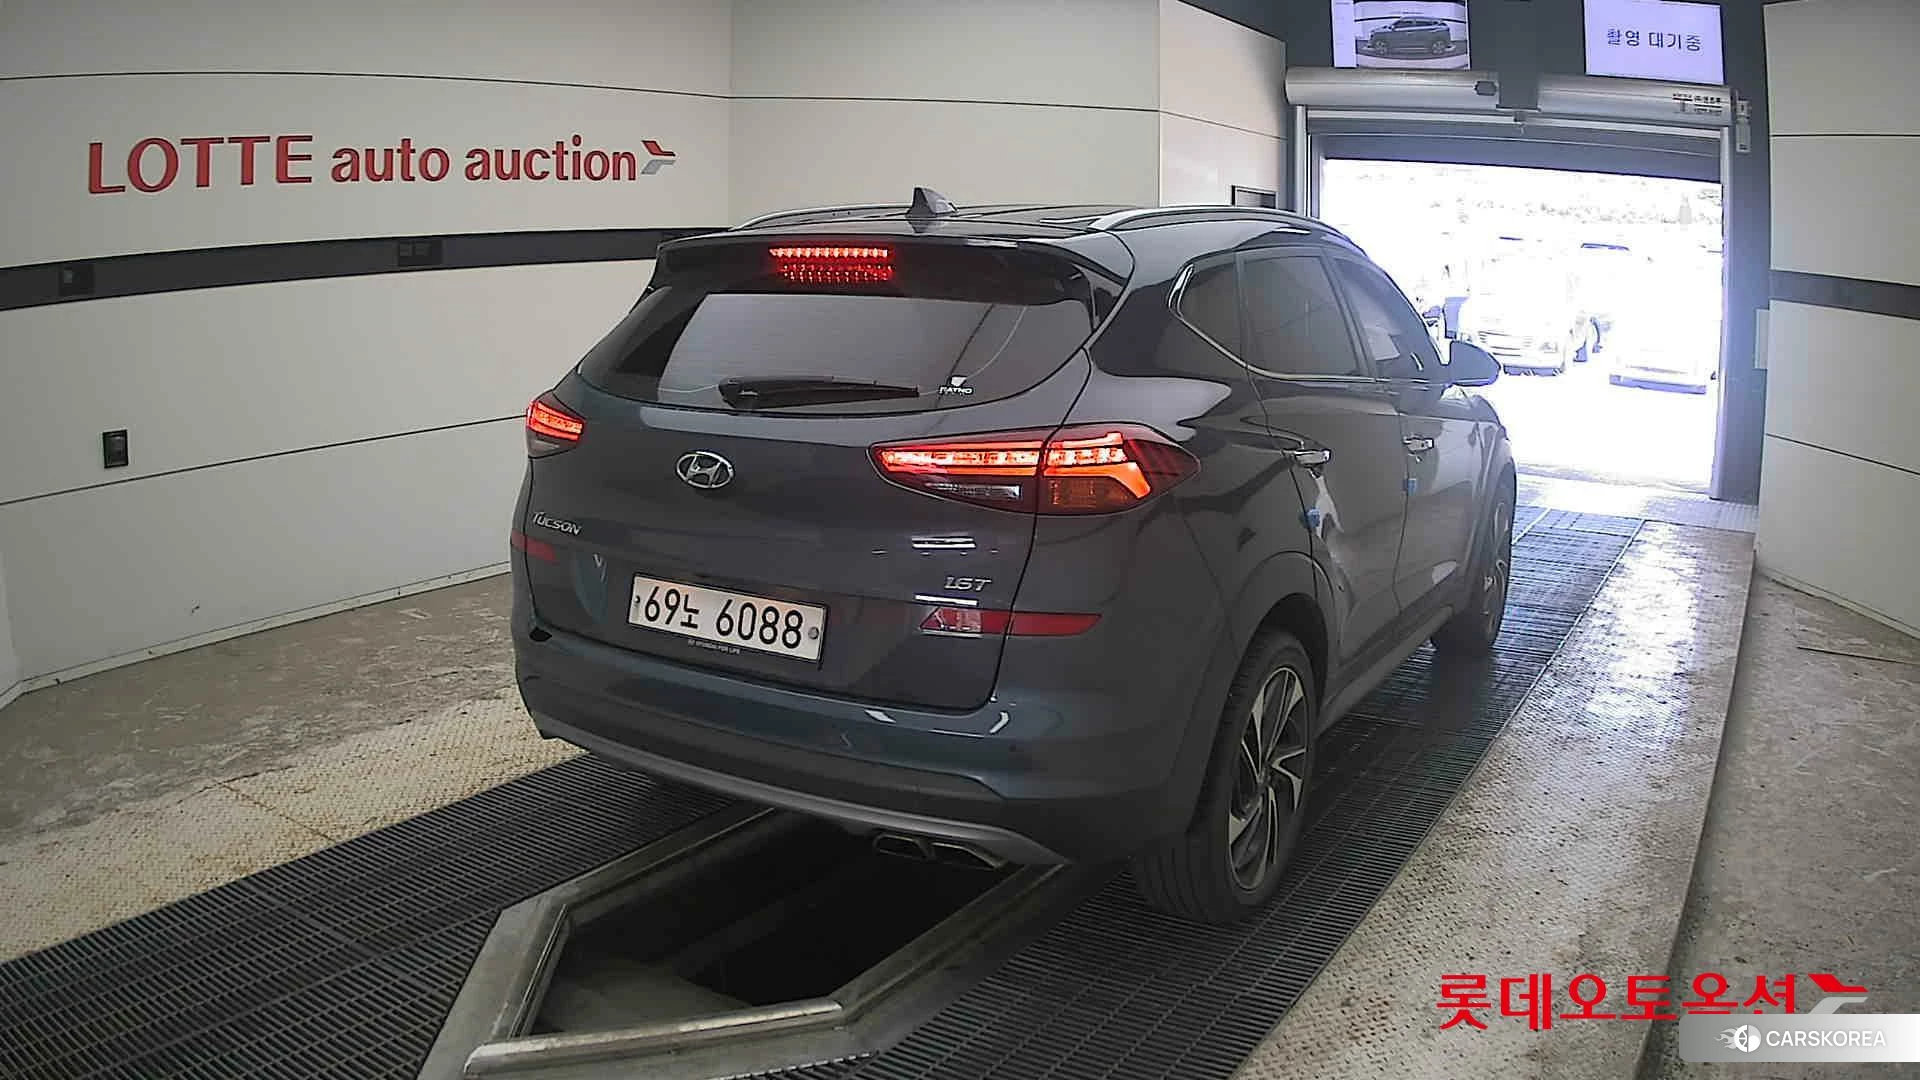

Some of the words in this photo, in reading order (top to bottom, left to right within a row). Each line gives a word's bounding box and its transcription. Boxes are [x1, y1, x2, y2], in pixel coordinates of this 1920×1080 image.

[1607, 28, 1640, 47] 촬영
[88, 135, 313, 194] LOTTE
[331, 138, 450, 182] auto
[465, 134, 637, 181] auction
[532, 511, 582, 535] TUCSON
[644, 586, 700, 629] 69노
[716, 599, 804, 650] 6088
